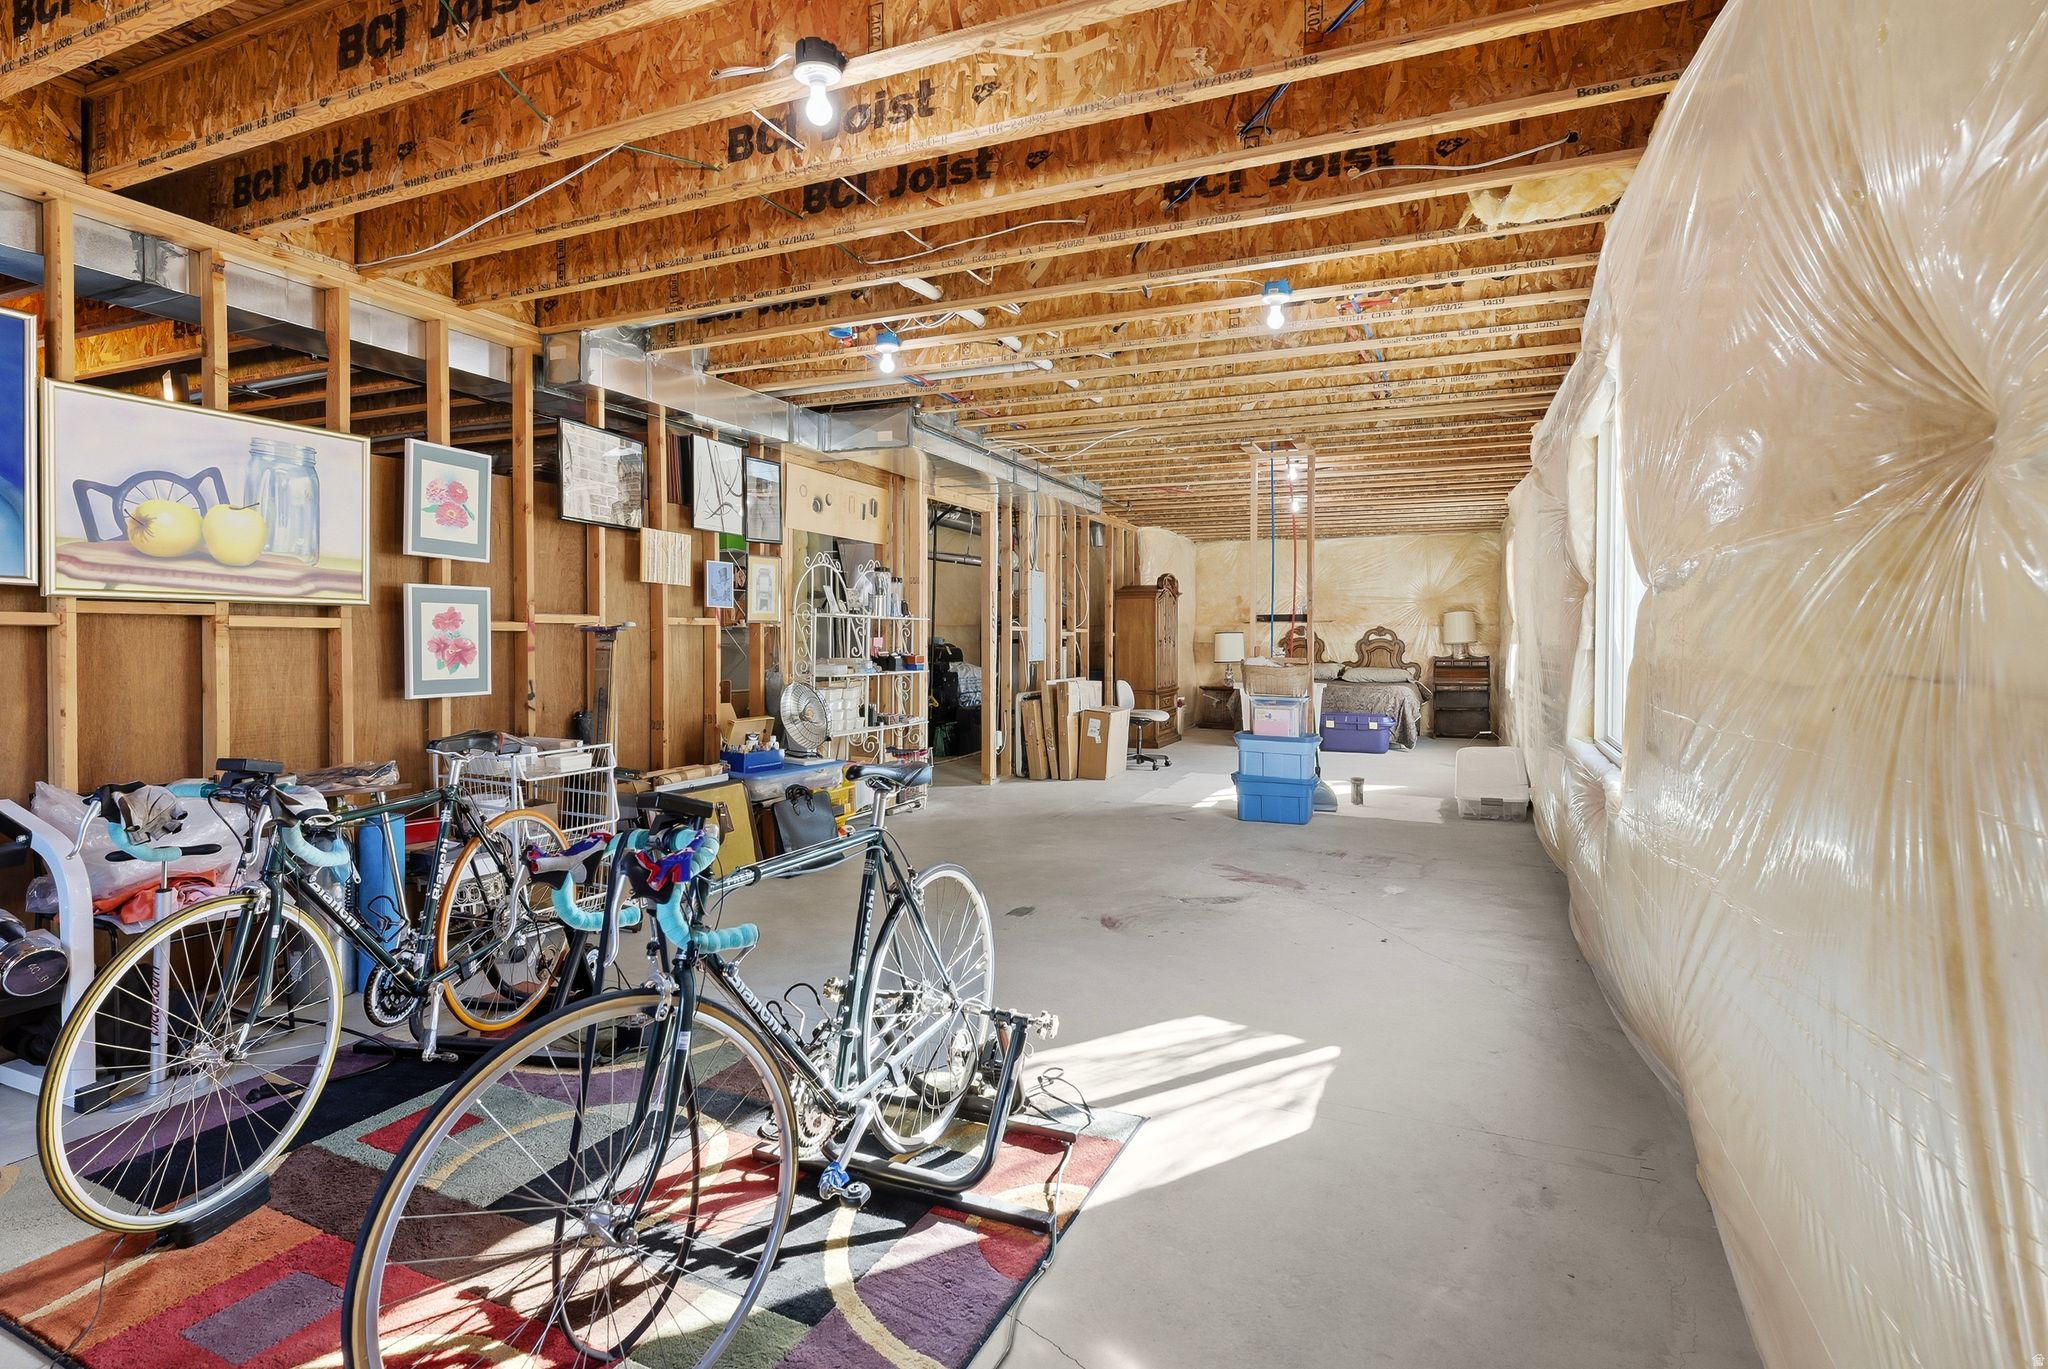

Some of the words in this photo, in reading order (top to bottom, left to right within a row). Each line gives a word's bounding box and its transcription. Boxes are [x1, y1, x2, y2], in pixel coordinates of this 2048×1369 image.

[339, 7, 407, 71] BCI
[1577, 82, 1620, 98] Boise
[728, 112, 798, 163] BCI
[233, 164, 287, 208] BCI
[295, 137, 374, 191] Joist
[803, 170, 867, 214] BCI
[889, 147, 996, 198] Joist
[432, 838, 449, 901] Bianchi
[307, 882, 361, 931] Bianchi
[858, 889, 876, 972] Bianchi
[727, 974, 782, 1036] Bianchi
